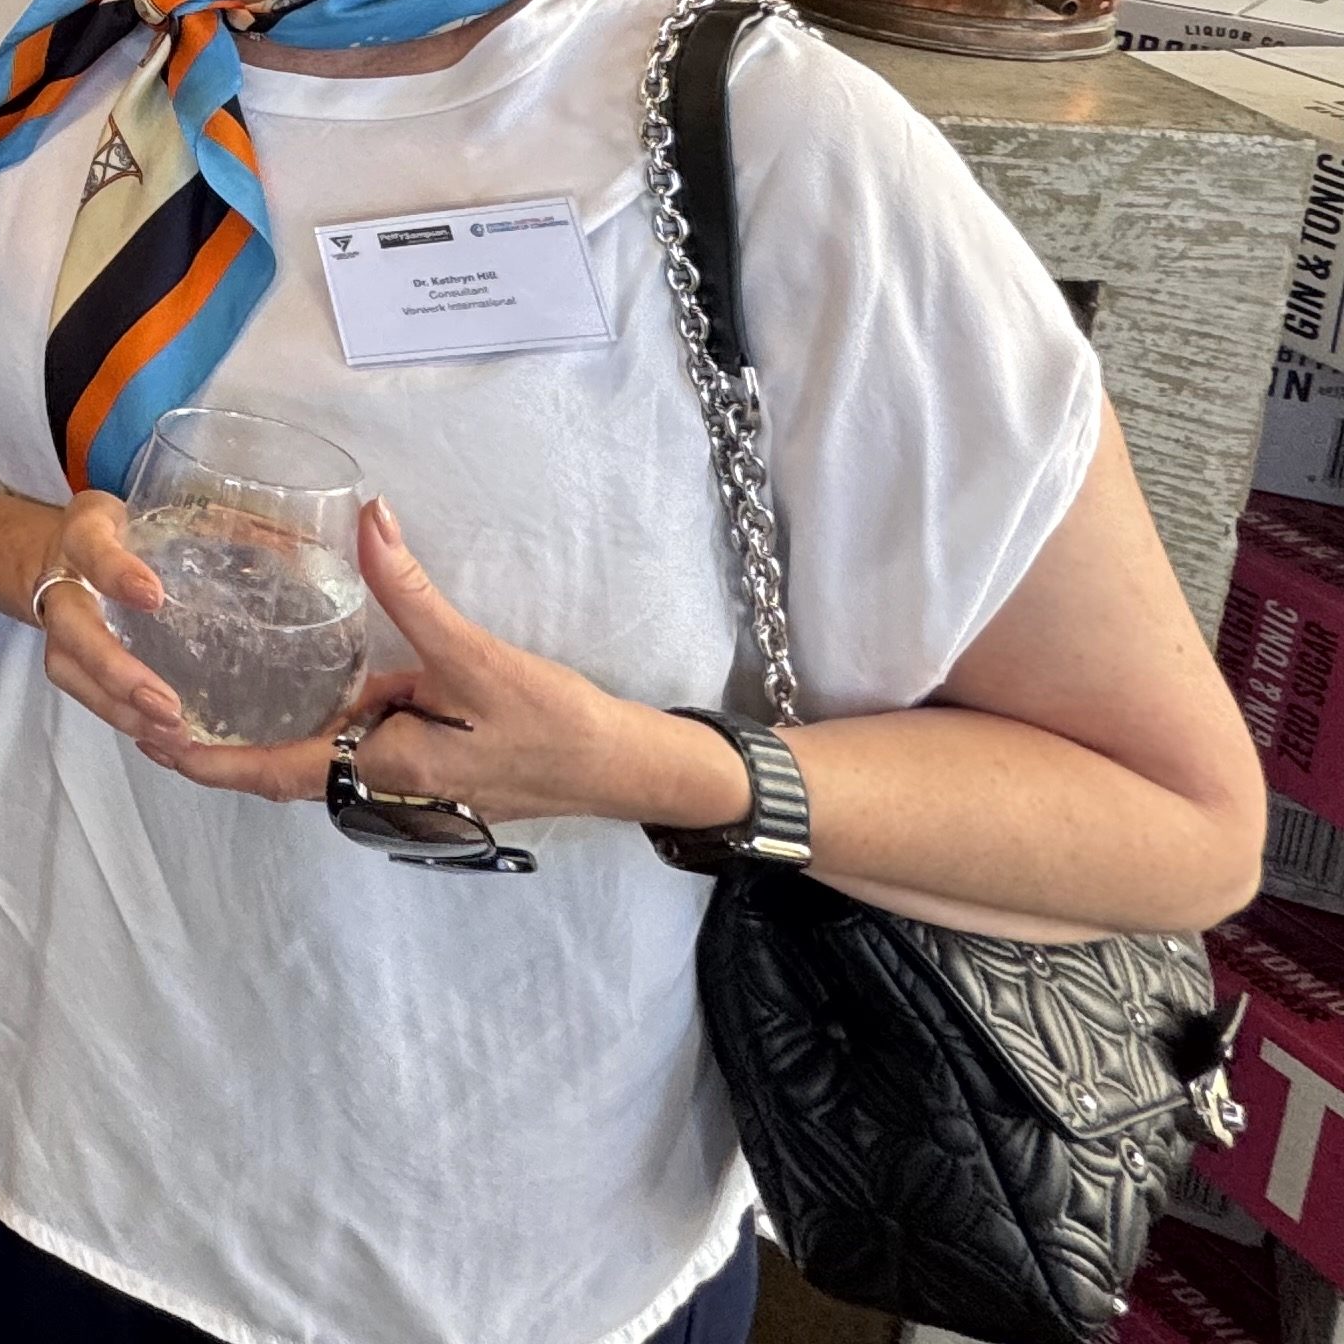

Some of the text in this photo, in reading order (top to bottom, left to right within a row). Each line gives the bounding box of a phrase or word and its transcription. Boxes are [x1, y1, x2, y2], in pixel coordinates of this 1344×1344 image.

[1185, 24, 1252, 43] LIQUOR
[1300, 154, 1344, 251] TONIC
[413, 270, 499, 288] Dr. Kathryn Hill
[429, 285, 489, 299] Consultant
[1295, 253, 1332, 282] &
[1283, 280, 1327, 341] GIN
[1268, 366, 1313, 403] IN
[1244, 599, 1299, 748] GIN & TONIC
[1292, 620, 1340, 706] SUGAR
[1278, 702, 1320, 775] ZERO
